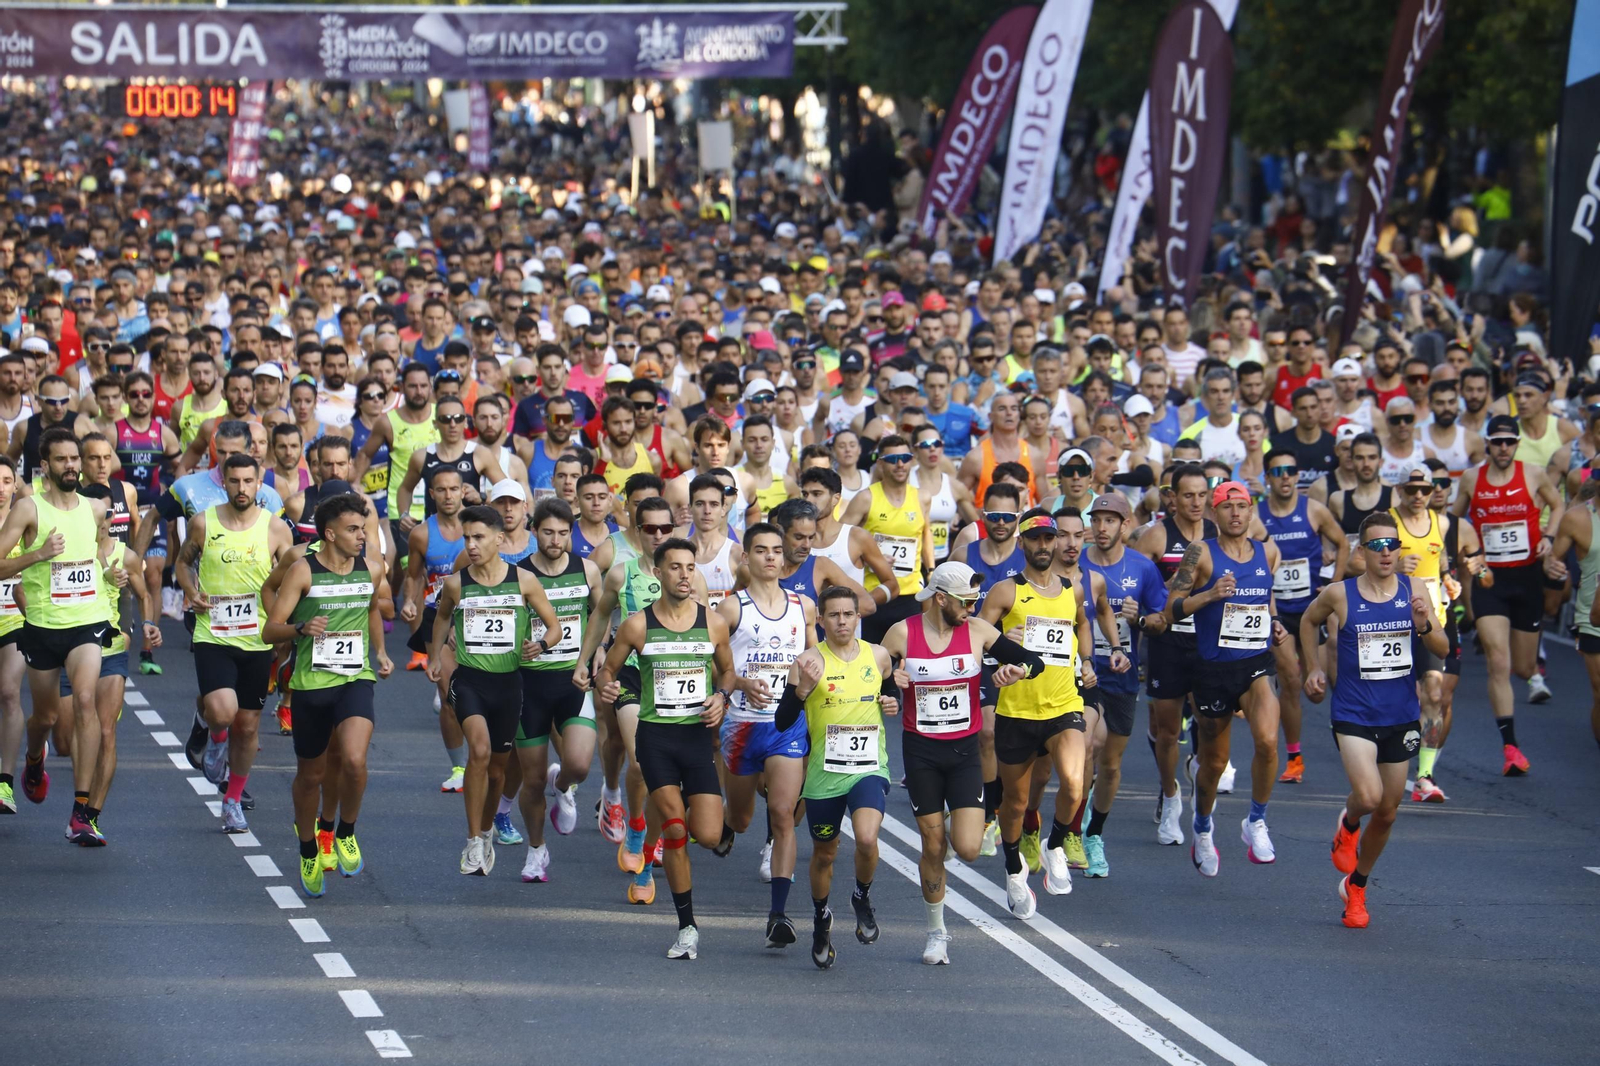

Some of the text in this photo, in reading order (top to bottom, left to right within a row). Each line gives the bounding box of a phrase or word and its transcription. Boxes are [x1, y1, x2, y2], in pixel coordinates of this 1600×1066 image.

[348, 25, 399, 42] MEDIA
[684, 24, 786, 44] AYUNTAMIENTO
[70, 21, 267, 66] SALIDA
[348, 35, 430, 58] MARATÓN
[500, 30, 609, 56] IMDECO
[684, 44, 702, 62] DE
[402, 59, 430, 73] 2024
[931, 44, 1010, 205] IMDECO
[131, 452, 152, 464] LUCAS
[1501, 531, 1518, 543] 55
[892, 545, 907, 558] 73
[67, 569, 92, 583] 403
[1283, 569, 1300, 581] 30
[225, 603, 252, 617] 174
[319, 601, 346, 610] ATLETISMO
[485, 618, 504, 633] 23
[1243, 615, 1262, 629] 28
[1355, 619, 1412, 632] TROTASIERRA
[1046, 628, 1064, 644] 62
[335, 640, 353, 654] 21
[1382, 642, 1402, 657] 26
[746, 651, 784, 662] LÁZARO
[655, 670, 666, 680] 38
[770, 674, 787, 689] 71
[677, 679, 696, 694] 76
[939, 695, 959, 711] 64
[849, 736, 869, 751] 37
